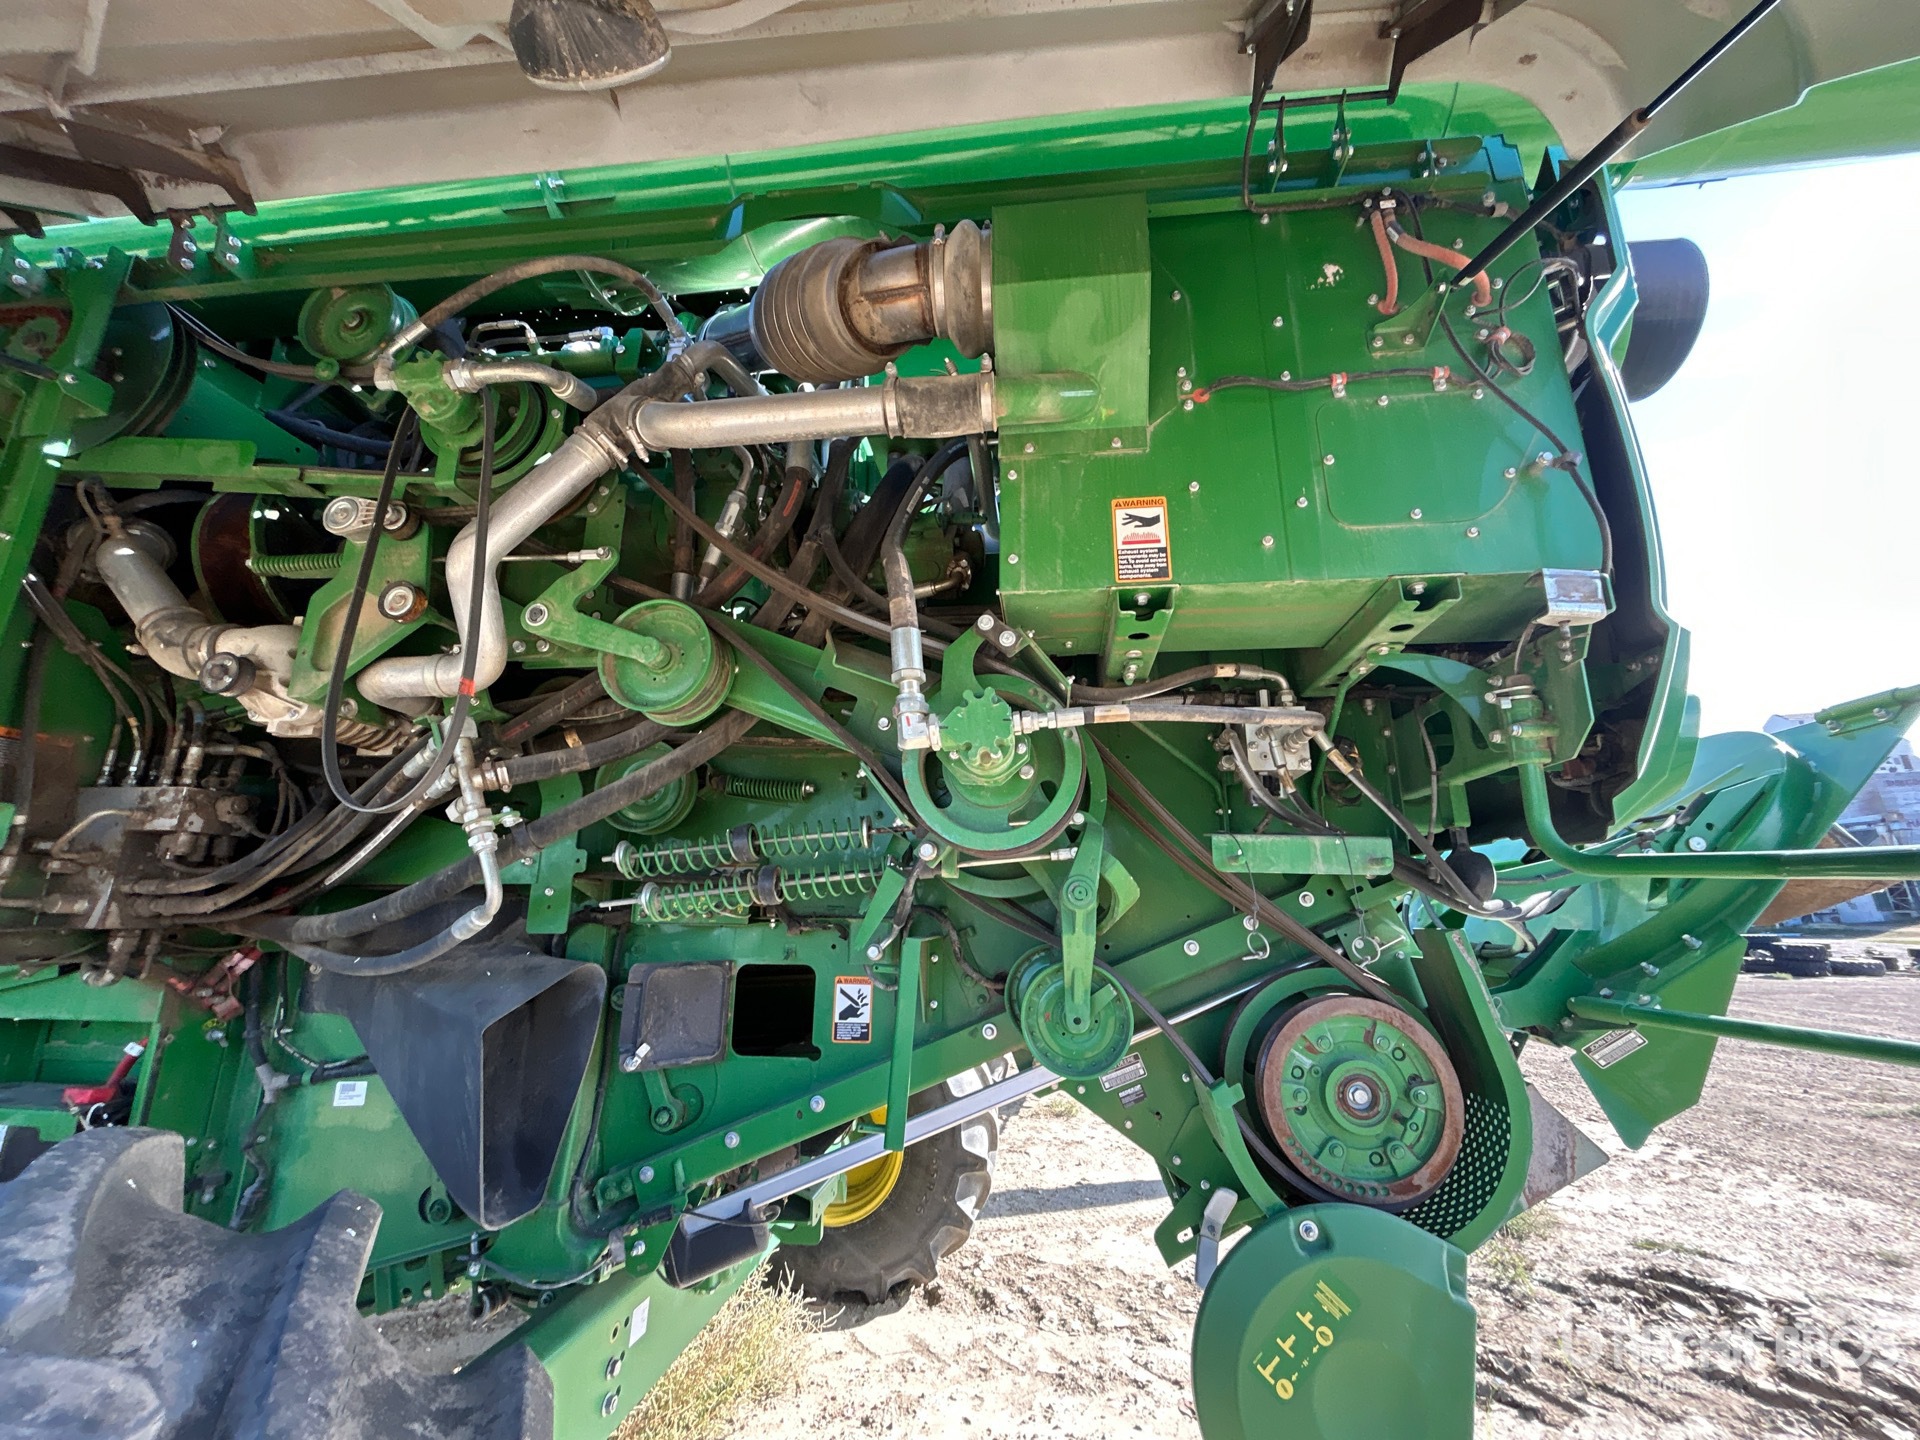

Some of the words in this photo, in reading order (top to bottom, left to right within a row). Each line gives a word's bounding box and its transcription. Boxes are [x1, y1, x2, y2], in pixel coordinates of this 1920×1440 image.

[1122, 499, 1164, 507] WARNING
[843, 977, 872, 985] WARNING
[1590, 1037, 1607, 1052] JOHN
